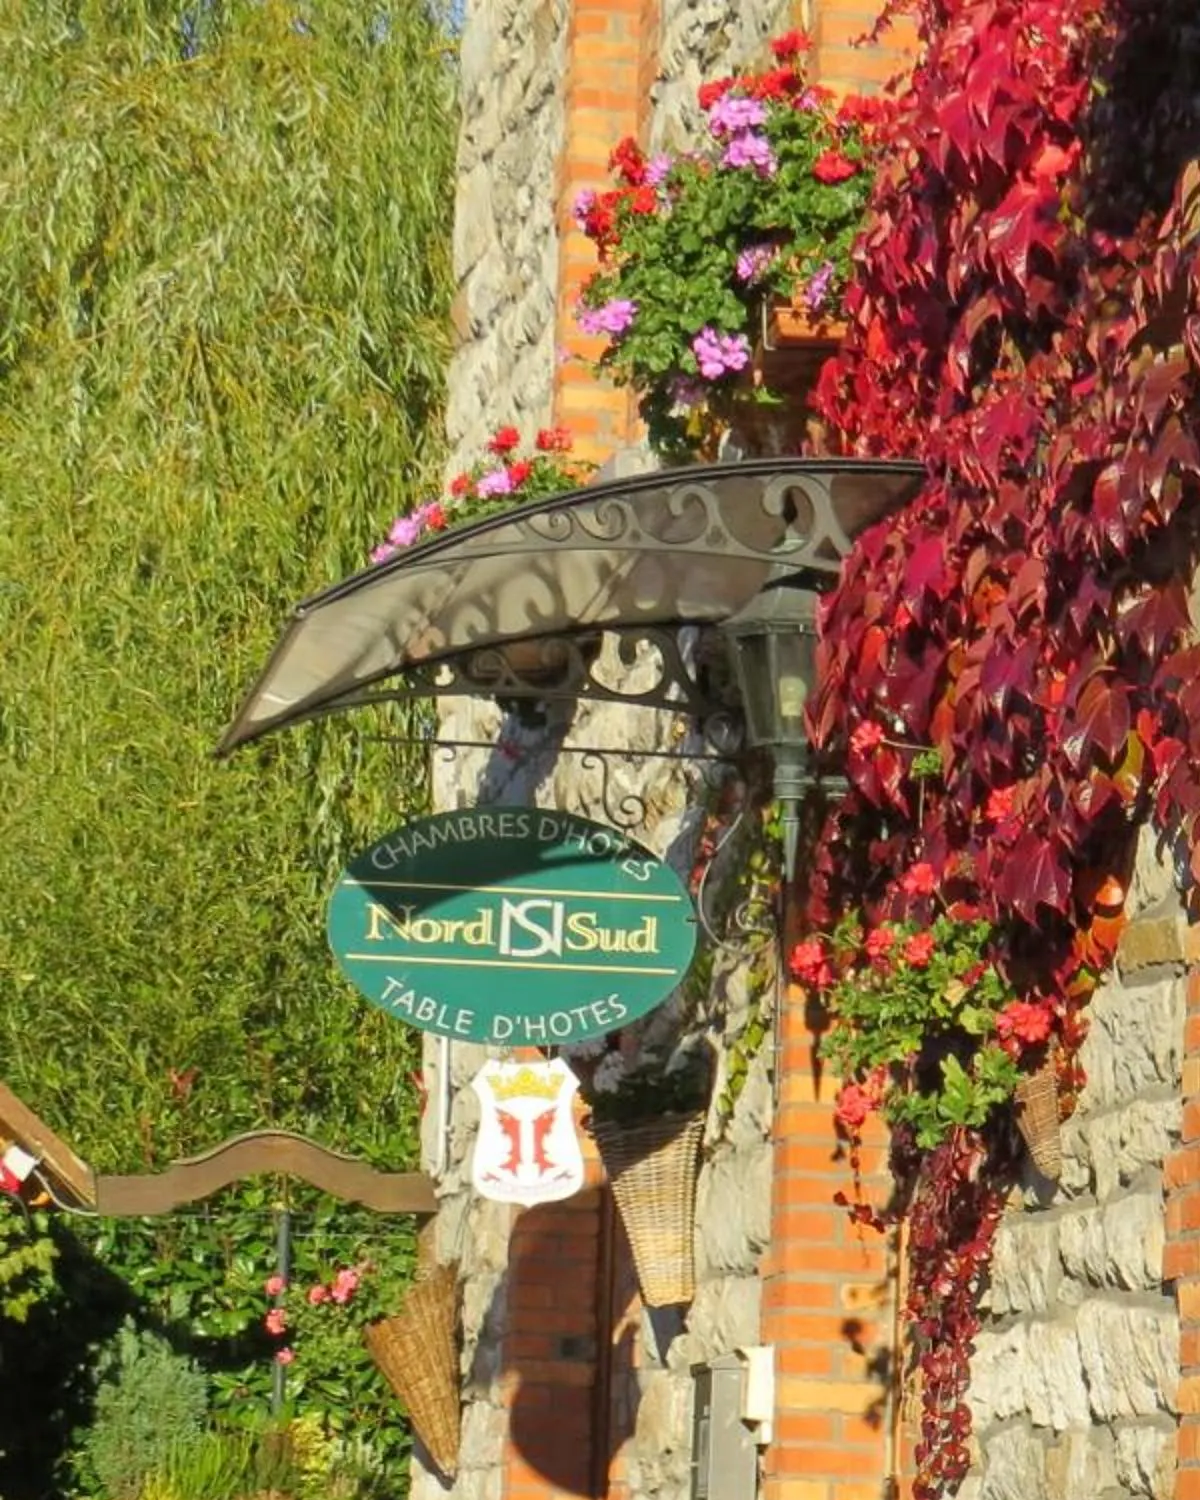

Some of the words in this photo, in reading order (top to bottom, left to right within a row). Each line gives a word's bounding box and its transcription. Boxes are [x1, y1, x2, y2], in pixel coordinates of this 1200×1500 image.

[371, 813, 532, 870] CHAMBRES
[537, 817, 659, 882] D'HOTES
[364, 902, 497, 946] Nord
[565, 911, 660, 954] Sud
[380, 975, 475, 1035] TABLE
[491, 992, 629, 1040] D'HOTES
